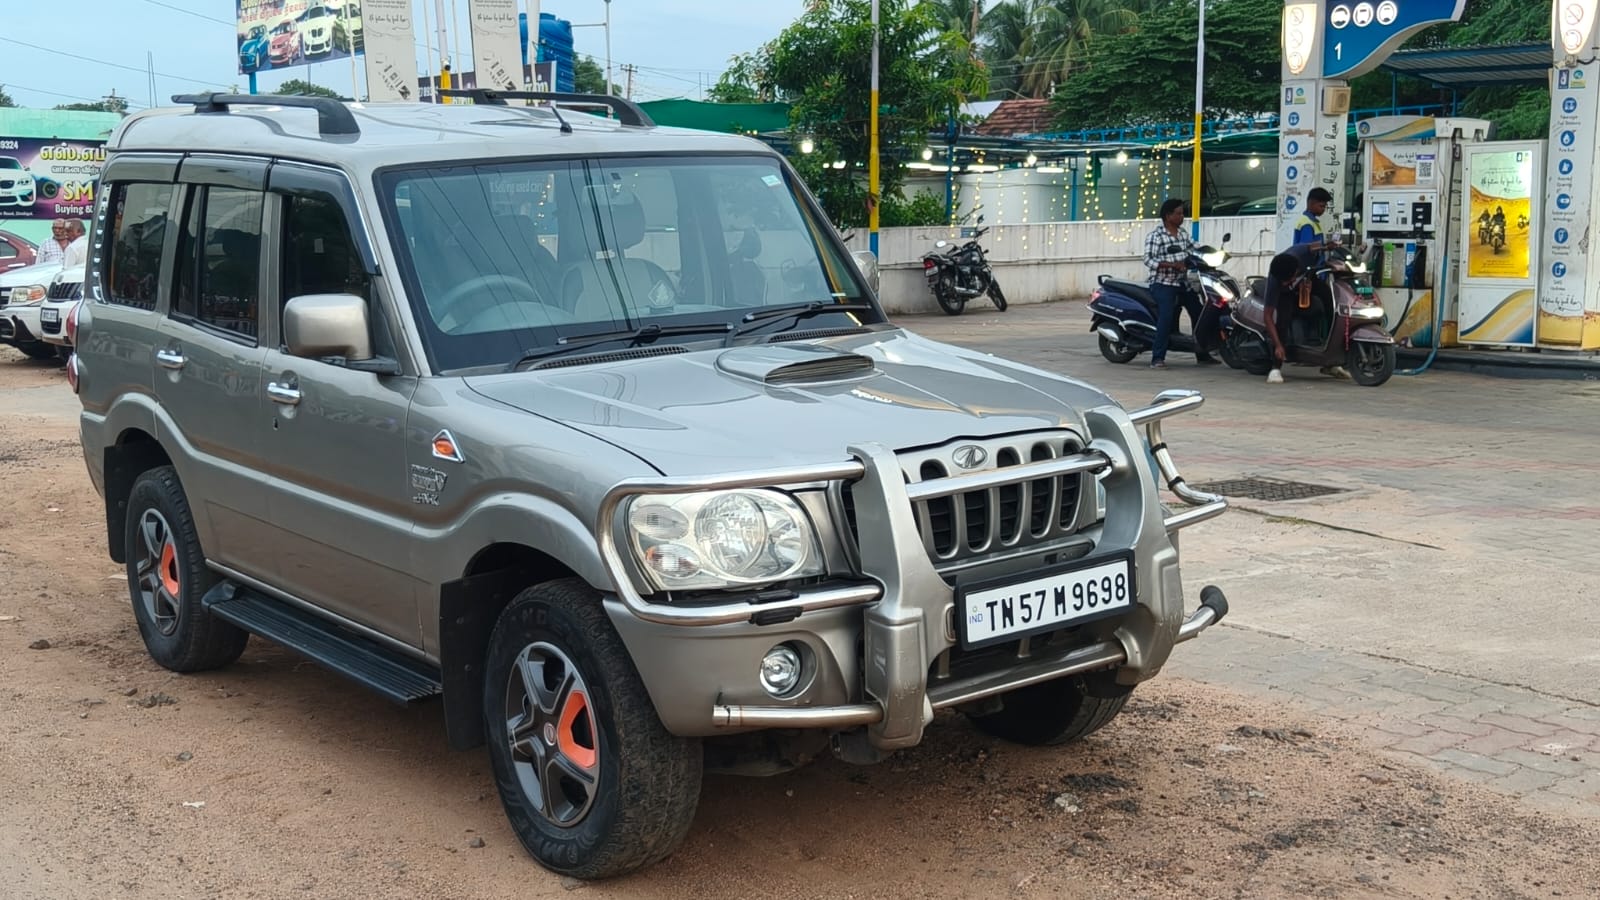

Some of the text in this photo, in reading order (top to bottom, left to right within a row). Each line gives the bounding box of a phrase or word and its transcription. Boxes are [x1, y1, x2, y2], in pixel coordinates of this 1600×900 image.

[1334, 42, 1343, 62] 1
[63, 179, 94, 201] SM
[55, 203, 84, 216] Buying
[986, 573, 1127, 632] TN 57 M 9698
[969, 613, 984, 625] IND
